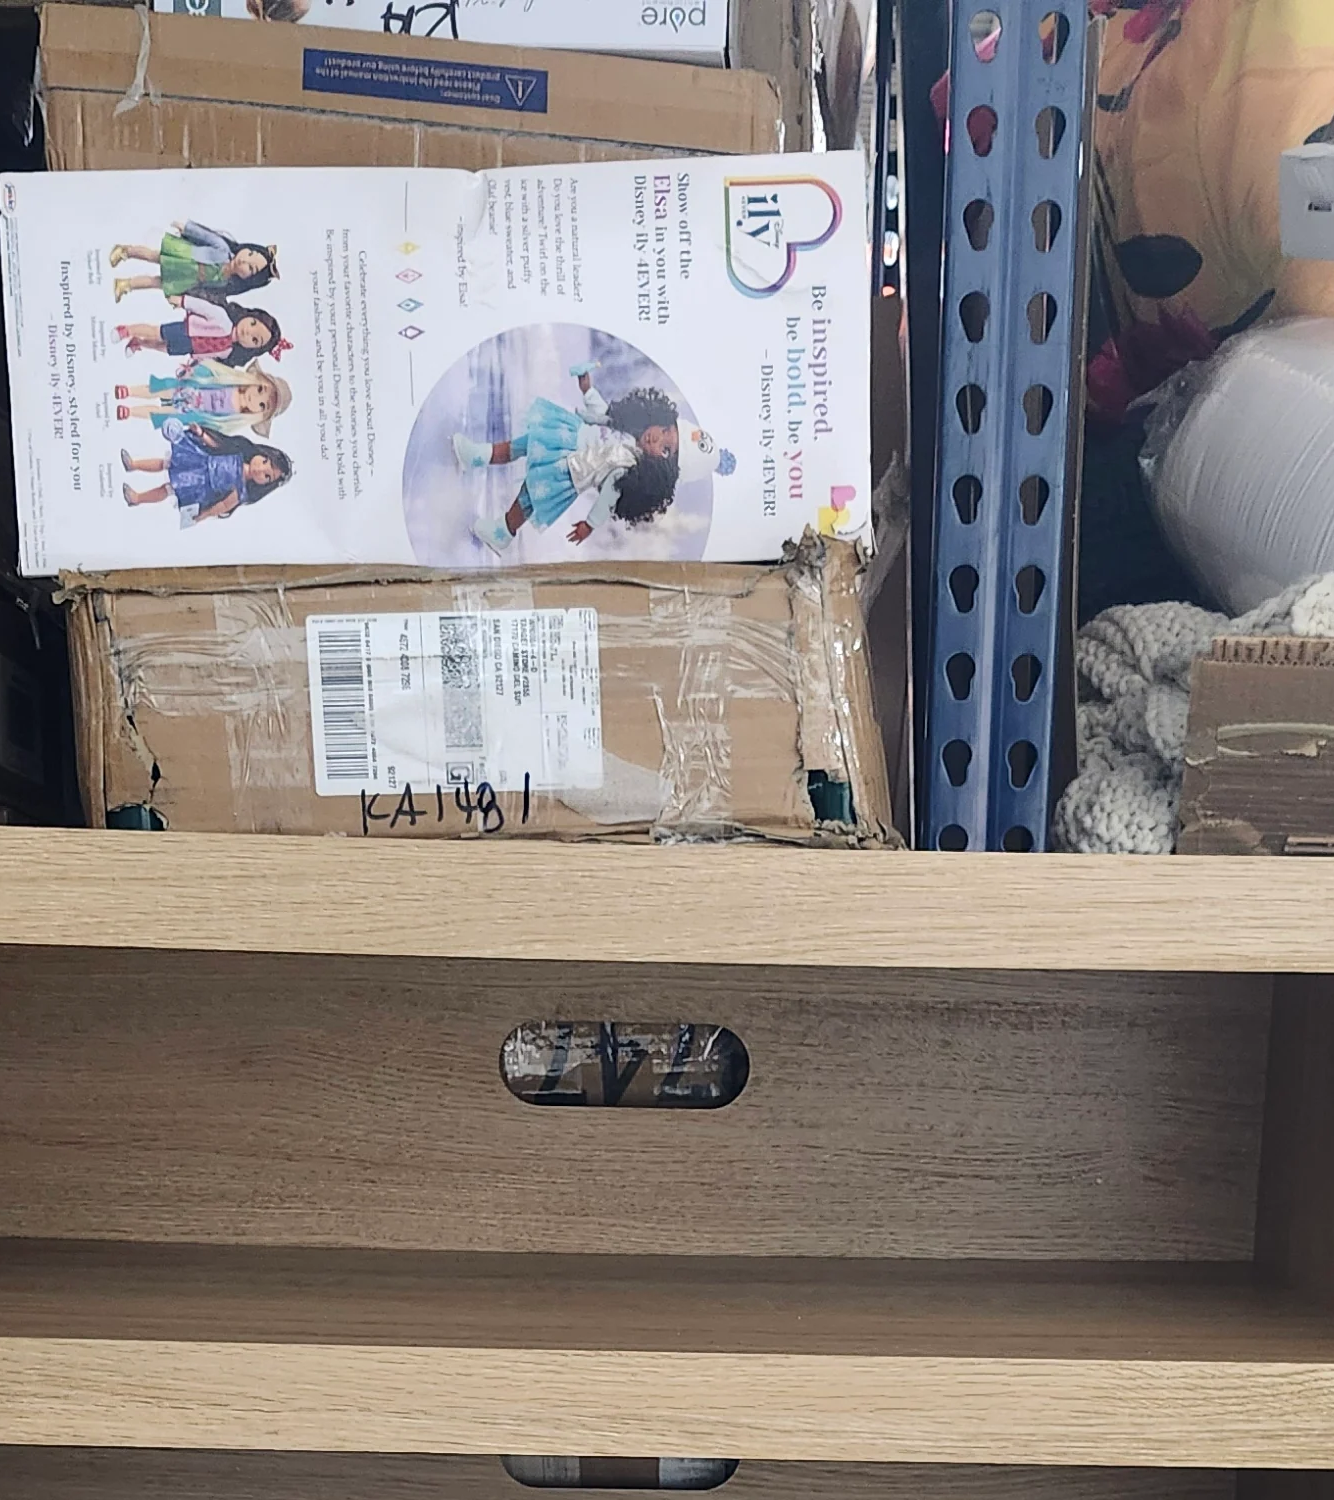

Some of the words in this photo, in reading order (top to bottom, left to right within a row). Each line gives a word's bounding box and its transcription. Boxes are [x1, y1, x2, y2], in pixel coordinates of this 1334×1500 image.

[554, 178, 563, 192] Do
[570, 178, 580, 194] Are
[677, 173, 690, 216] Show
[550, 194, 562, 212] you
[567, 196, 578, 214] you
[632, 175, 648, 227] Disney
[653, 175, 670, 220] Elsa
[554, 214, 564, 235] love
[736, 194, 782, 247] ily
[326, 229, 335, 240] Be
[342, 229, 351, 252] from
[555, 238, 565, 253] the
[571, 225, 581, 262] natural
[634, 233, 648, 252] ily
[655, 226, 668, 244] in
[678, 220, 691, 247] off
[324, 243, 337, 285] inspired
[340, 254, 352, 279] your
[358, 250, 368, 298] Celebrate
[556, 256, 565, 282] thrill
[653, 248, 667, 280] you
[679, 251, 691, 279] the
[58, 260, 73, 319] Inspired
[310, 271, 321, 295] your
[327, 288, 338, 301] by
[556, 285, 566, 295] of
[572, 265, 583, 302] leader?
[637, 258, 651, 322] 4EVER!
[343, 281, 354, 320] favorite
[656, 285, 670, 325] with
[811, 285, 827, 310] Be
[328, 303, 338, 326] your
[62, 323, 76, 339] by
[360, 300, 371, 355] everything
[786, 316, 801, 341] be
[45, 324, 59, 368] Disney
[315, 339, 325, 358] and
[328, 329, 341, 372] personal
[346, 322, 356, 372] characters
[316, 360, 325, 372] be
[361, 357, 372, 376] you
[47, 373, 62, 390] ily
[314, 374, 325, 394] you
[331, 374, 342, 408] Disney
[348, 375, 357, 385] to
[364, 379, 374, 400] love
[319, 396, 327, 406] in
[349, 387, 358, 403] the
[759, 365, 775, 423] Disney
[51, 392, 64, 439] 4EVER!
[67, 397, 82, 439] styled
[319, 409, 328, 421] all
[349, 405, 360, 437] stories
[365, 402, 375, 430] about
[316, 423, 327, 442] you
[335, 439, 344, 450] be
[759, 429, 775, 449] ily
[787, 421, 802, 444] be
[71, 442, 82, 463] for
[320, 444, 329, 460] do!
[350, 439, 361, 459] you
[366, 433, 376, 467] Disney
[336, 453, 346, 475] bold
[783, 449, 803, 500] you
[69, 466, 82, 491] you
[338, 478, 347, 500] with
[762, 454, 776, 517] 4EVER!
